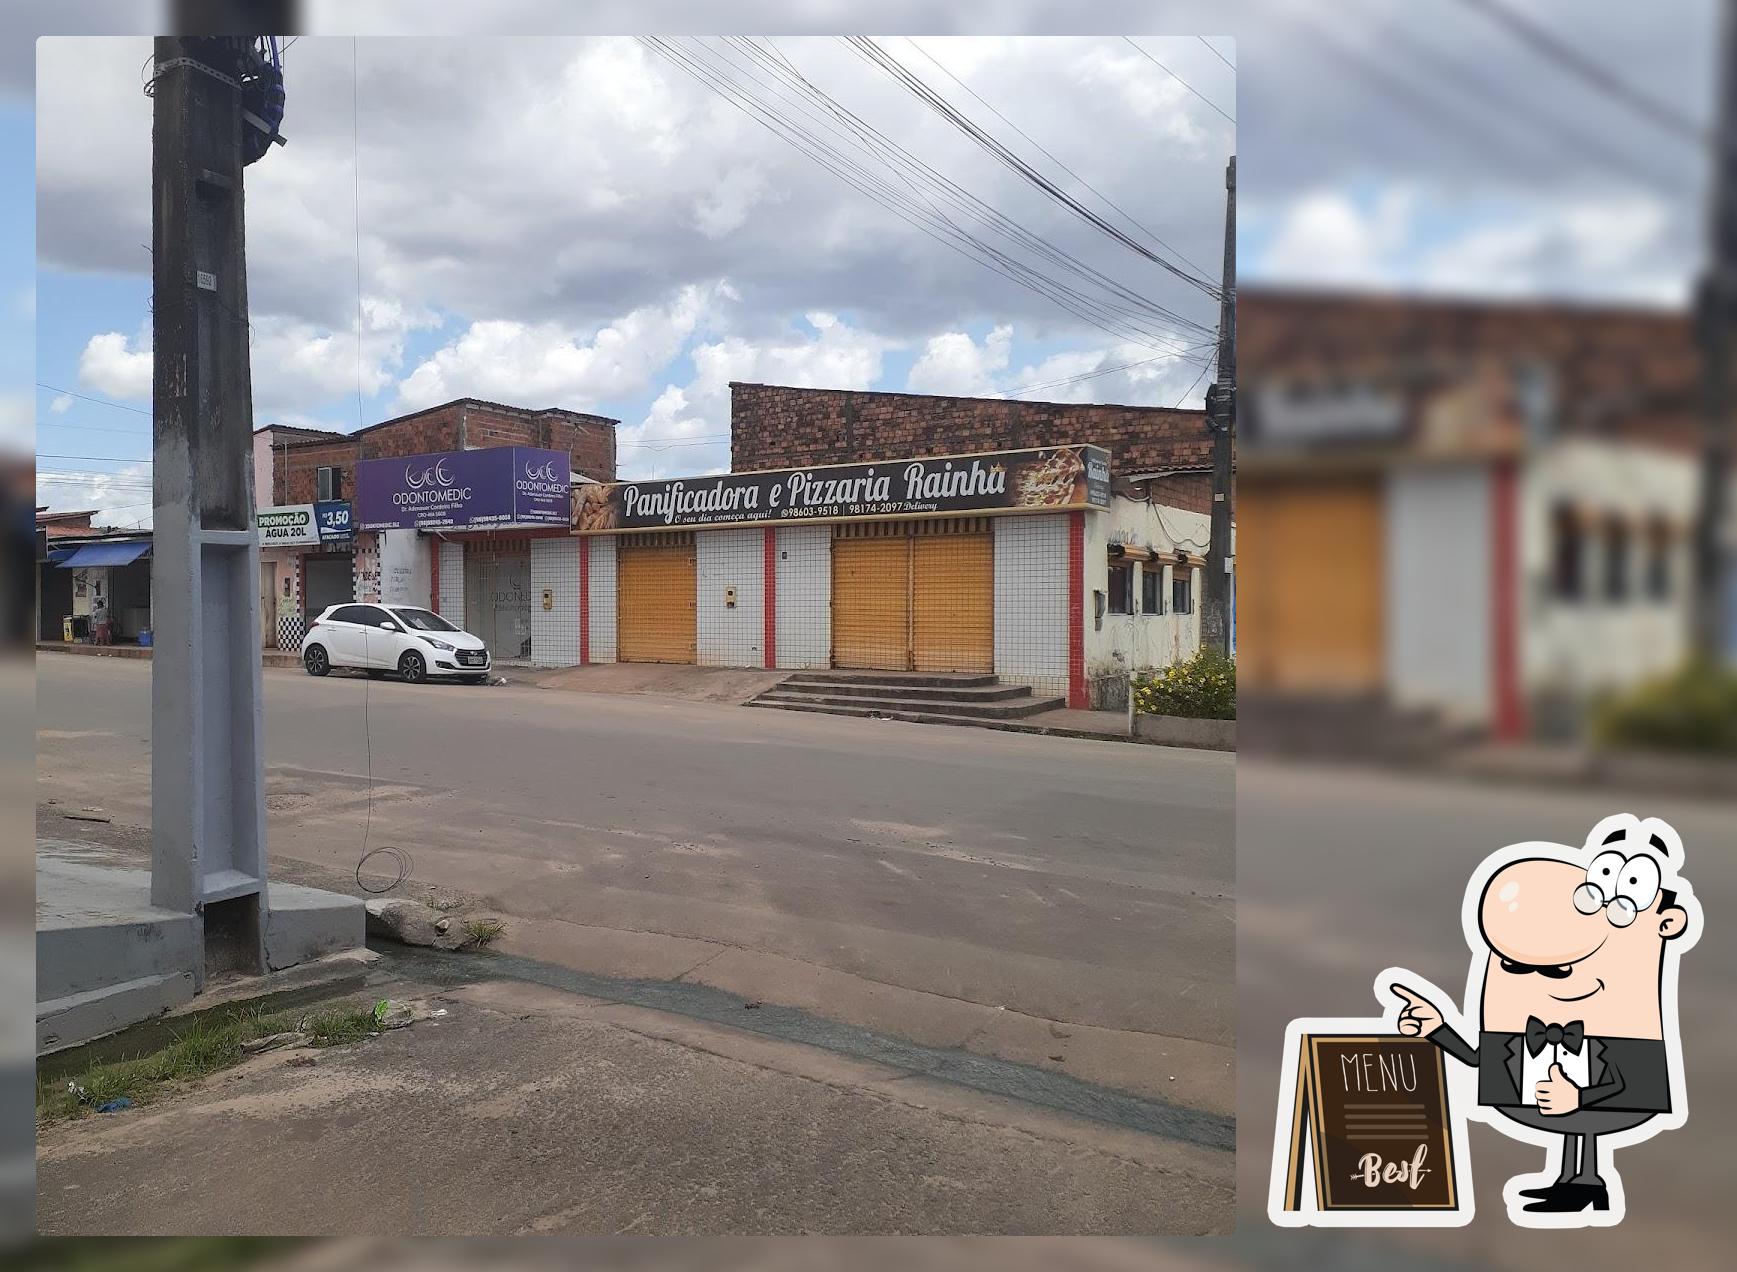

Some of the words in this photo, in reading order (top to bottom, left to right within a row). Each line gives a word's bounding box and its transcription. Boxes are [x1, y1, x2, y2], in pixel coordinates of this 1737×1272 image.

[516, 480, 569, 494] ODONTOMEDIC
[623, 480, 759, 524] Panificadora
[769, 483, 782, 507] e
[787, 468, 891, 507] Pizzaria
[903, 460, 1006, 500] Rainha
[393, 487, 471, 505] ODONTOMEDIC
[698, 513, 712, 522] dia
[714, 513, 744, 522] começa
[744, 508, 772, 521] aqui!
[788, 505, 839, 517] 98603-9518
[849, 502, 902, 514] 98174-2097
[903, 502, 938, 511] Delivery
[259, 512, 306, 526] PROMOÇÃO
[327, 510, 348, 528] 3,50
[290, 528, 306, 537] 20L
